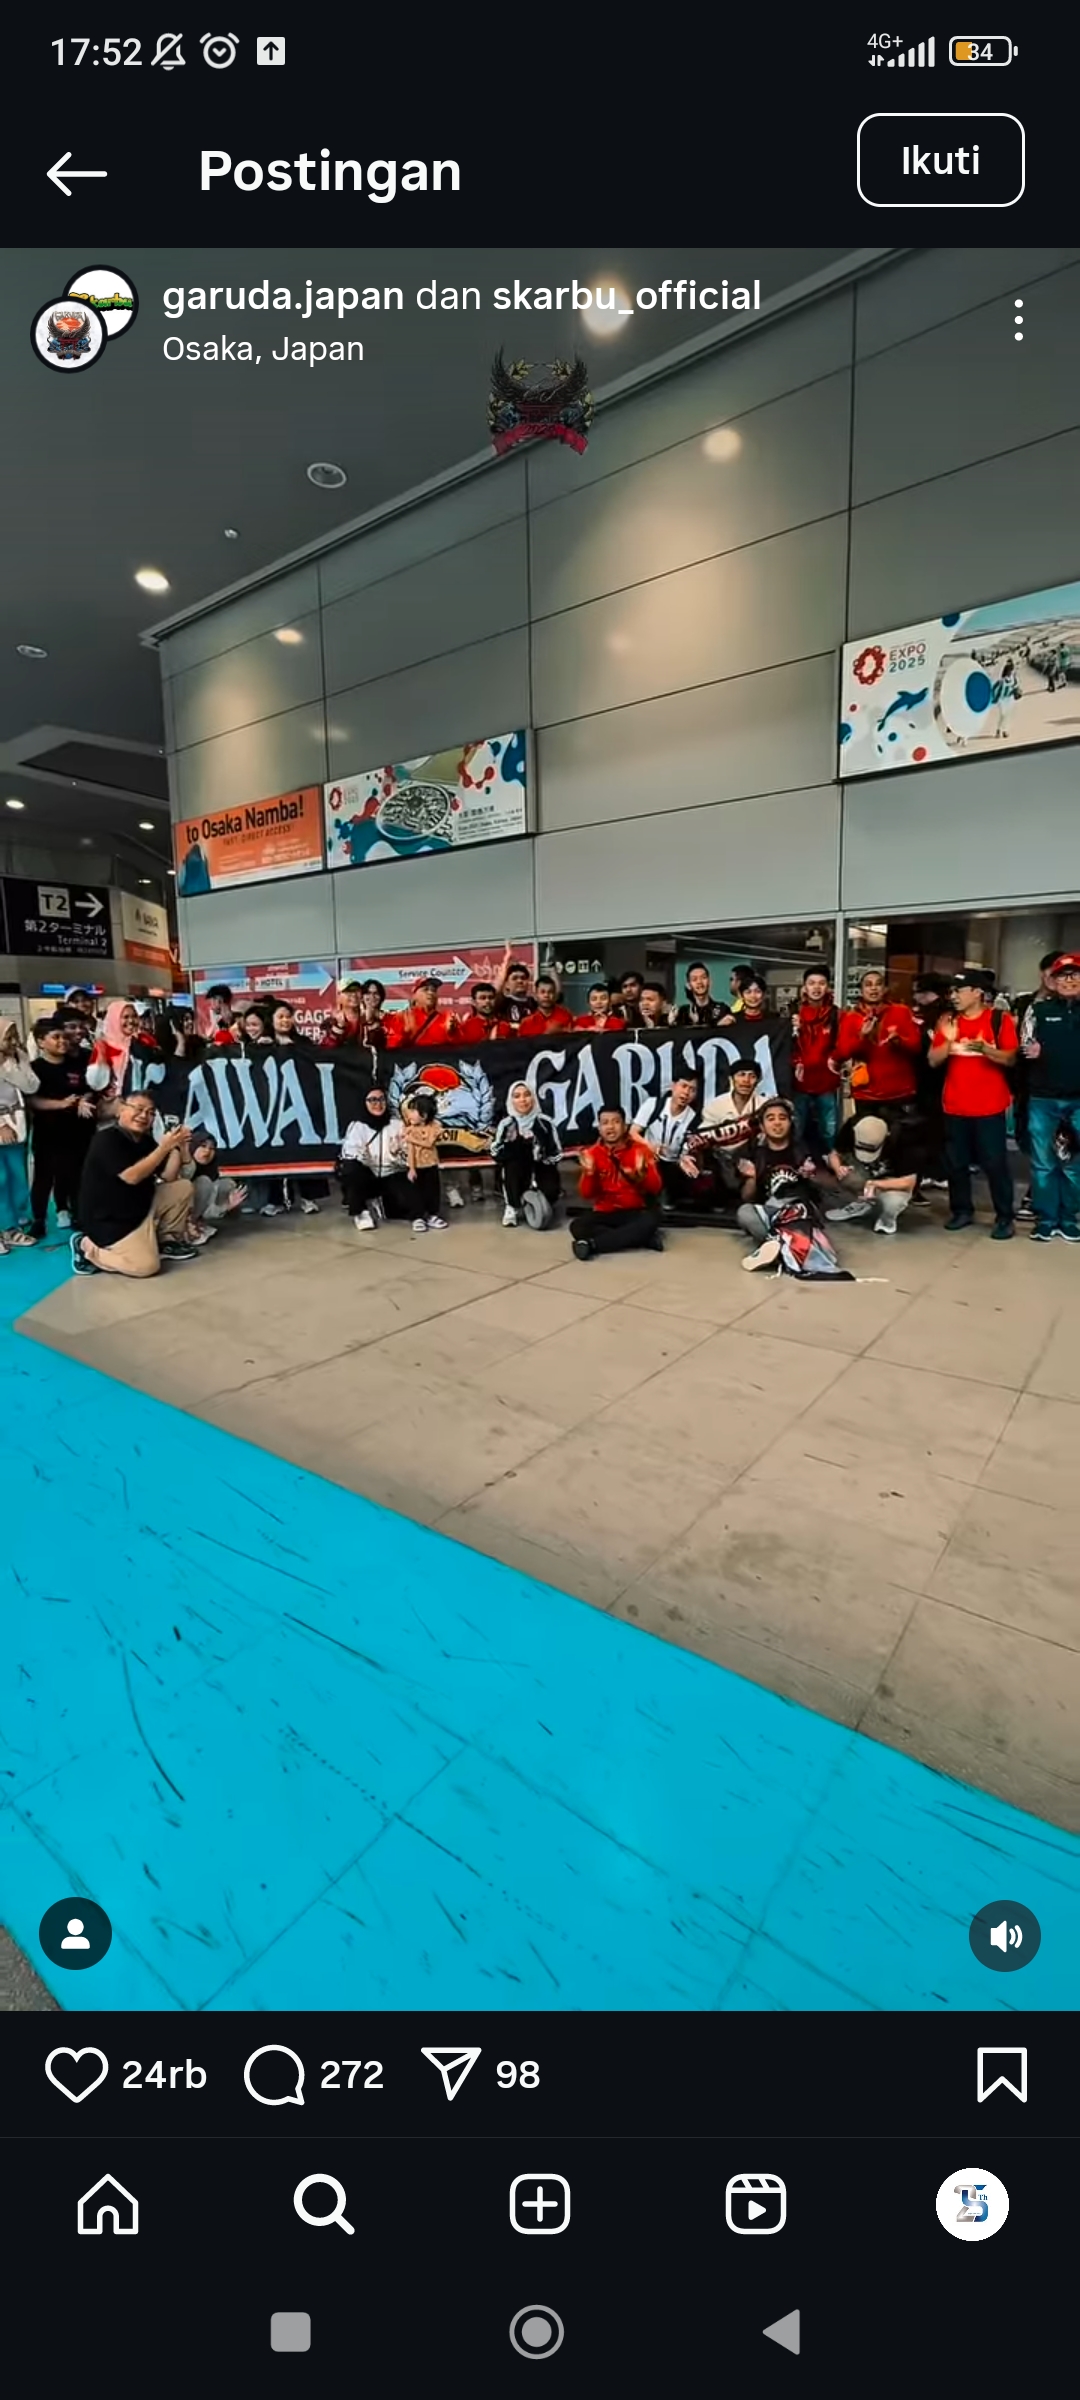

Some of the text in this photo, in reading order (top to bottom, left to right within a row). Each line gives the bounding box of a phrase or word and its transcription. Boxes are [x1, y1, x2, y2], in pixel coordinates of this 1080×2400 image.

[889, 642, 926, 661] EXPO
[889, 655, 926, 673] 2025
[186, 794, 304, 844] to Osaka Namba!
[41, 894, 69, 912] T2
[24, 919, 107, 936] 第2ターミナル
[57, 934, 107, 947] Terminal 2
